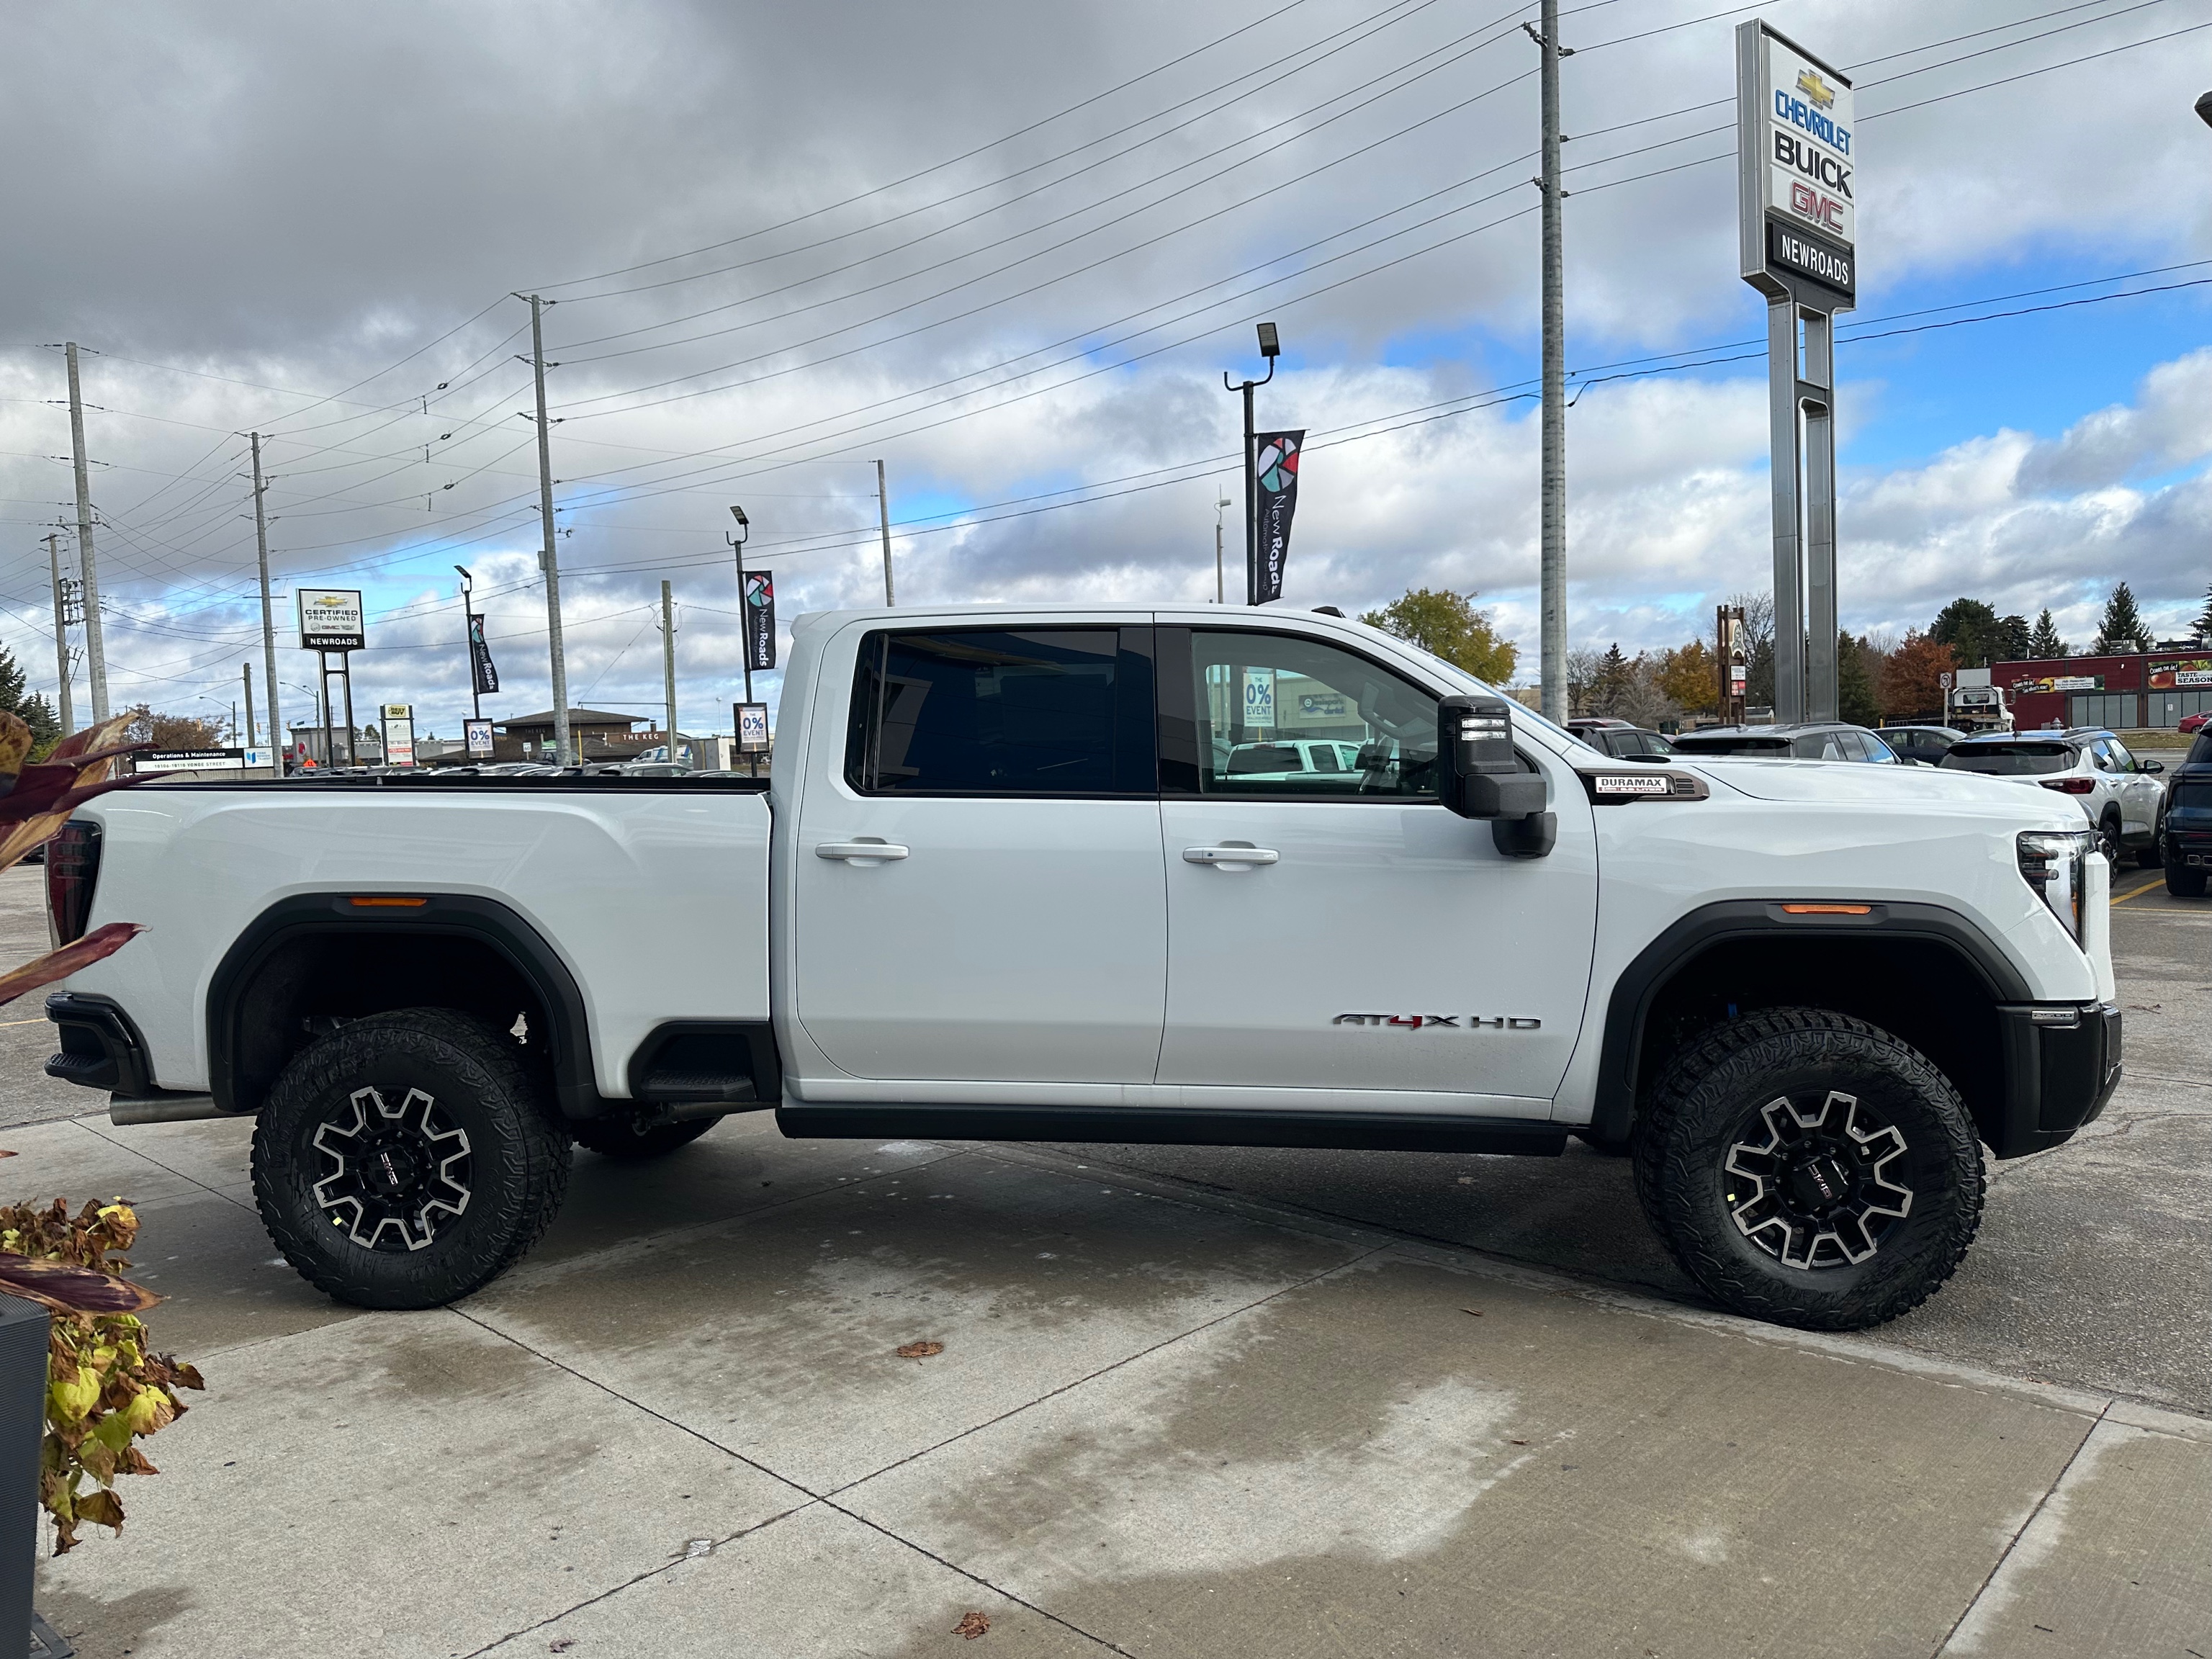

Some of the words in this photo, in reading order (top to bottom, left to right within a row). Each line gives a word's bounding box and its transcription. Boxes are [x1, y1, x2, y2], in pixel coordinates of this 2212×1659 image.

[1775, 89, 1851, 156] CHEVROLET
[1775, 130, 1852, 199] BUICK
[1790, 179, 1844, 235] GMC
[1781, 235, 1849, 285] NEWROADS
[1246, 683, 1272, 705] 0%
[1246, 706, 1272, 715] EVENT
[470, 730, 490, 740] 0%
[743, 717, 764, 729] 0%
[1332, 1012, 1460, 1030] AT4X
[1470, 1015, 1542, 1029] HD
[381, 1152, 398, 1186] GMC
[1808, 1164, 1833, 1199] GMC
